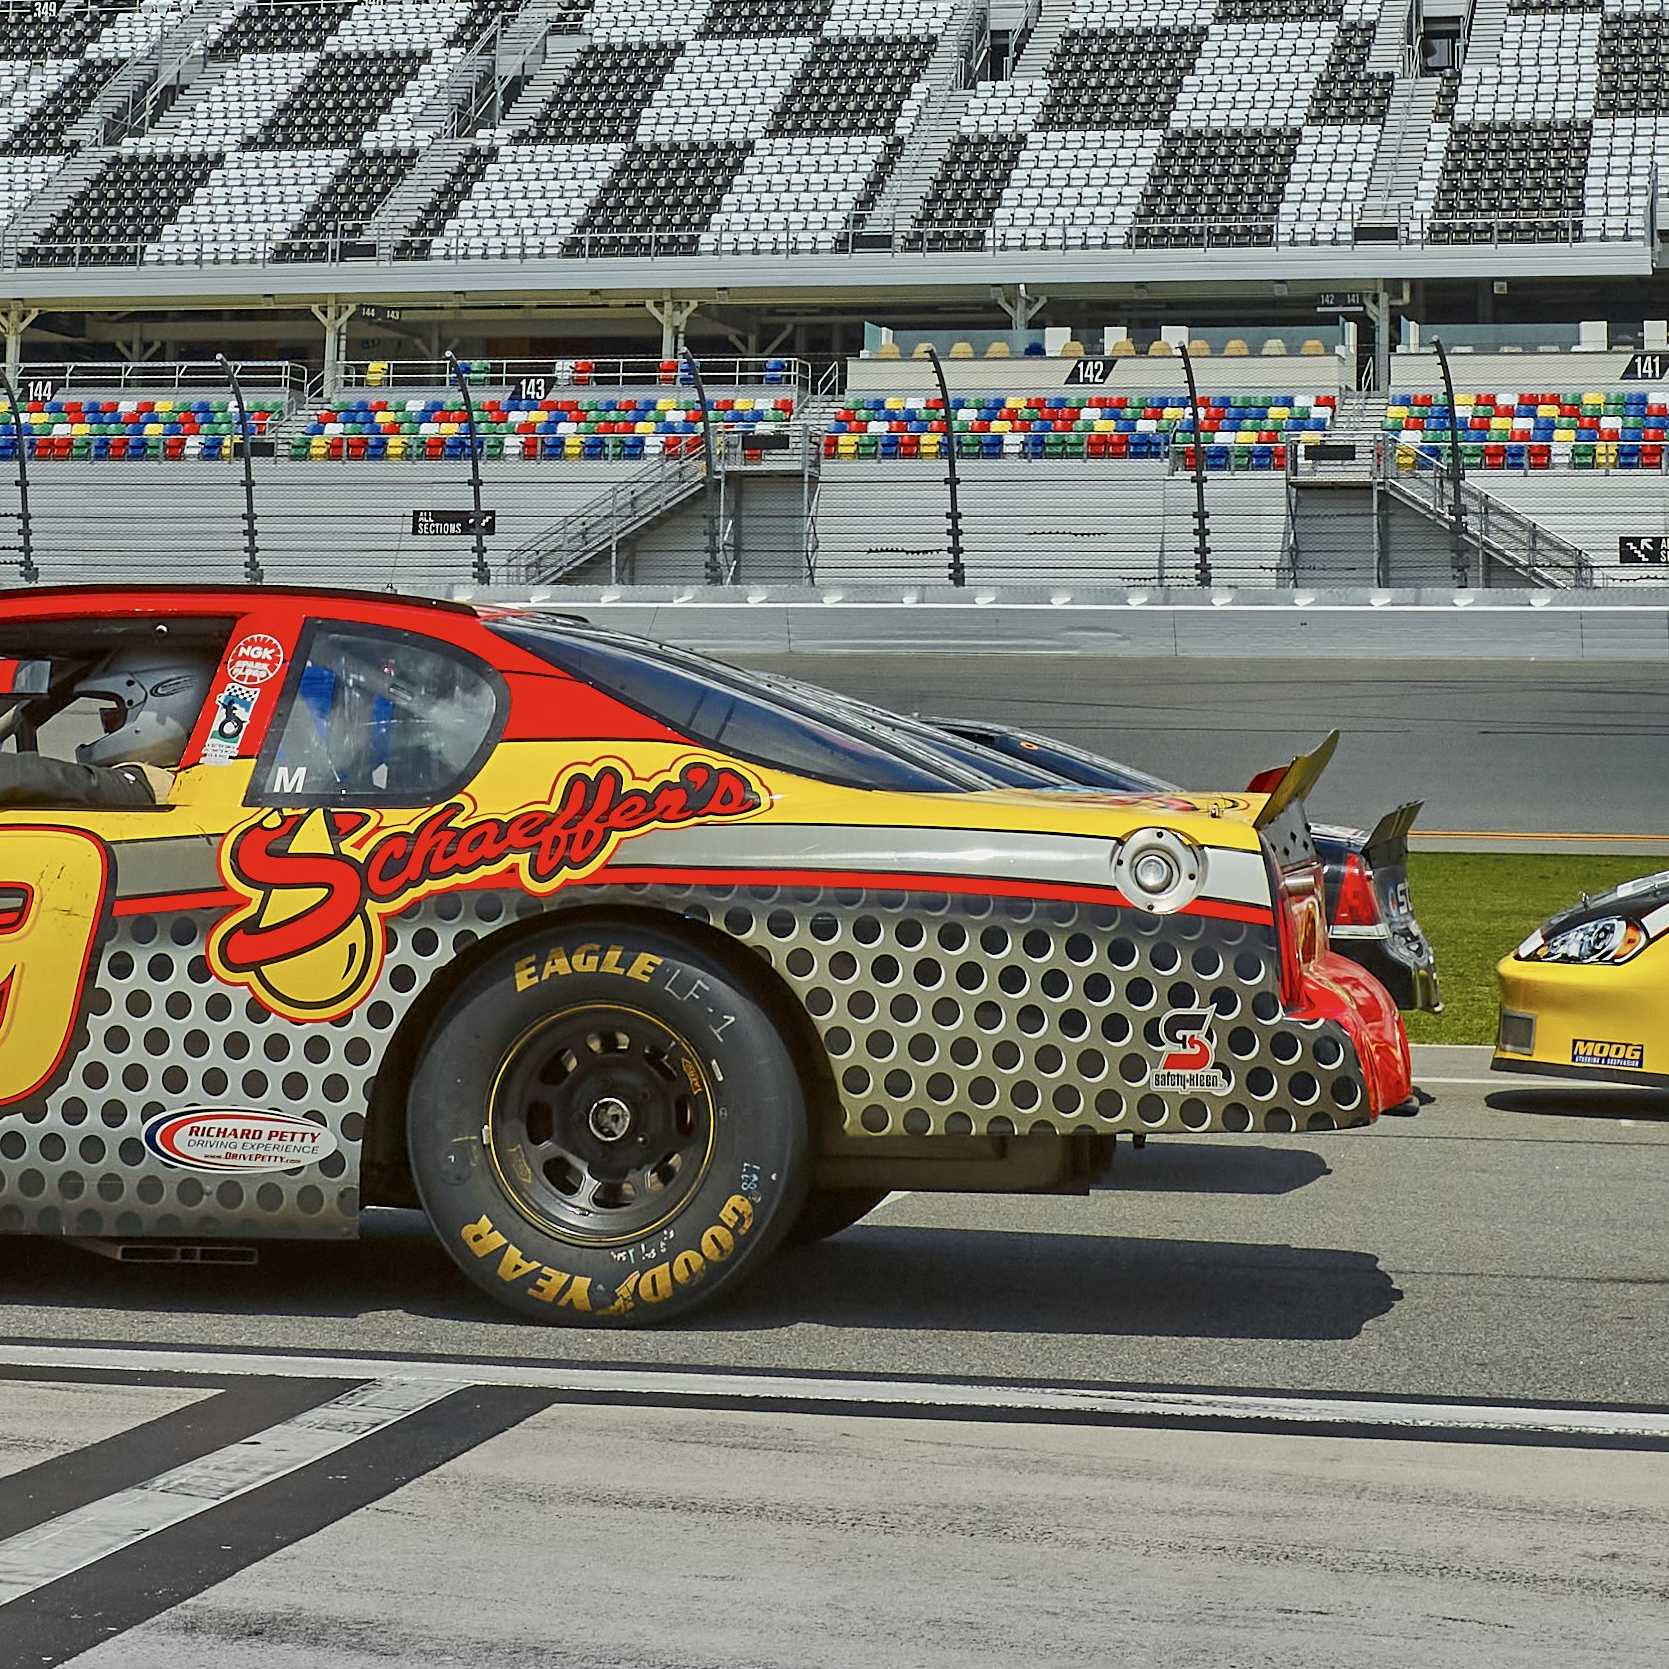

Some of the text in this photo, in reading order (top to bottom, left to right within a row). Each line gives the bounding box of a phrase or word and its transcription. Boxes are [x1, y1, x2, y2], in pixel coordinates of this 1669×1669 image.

[34, 1, 56, 17] 349
[1320, 294, 1360, 304] 142 141
[1077, 360, 1105, 383] 142
[1634, 355, 1661, 379] 141
[27, 381, 53, 401] 144
[519, 378, 546, 401] 143
[418, 512, 434, 522] ALL
[417, 522, 462, 534] SECTIONS
[238, 645, 276, 661] NGK
[273, 766, 307, 793] M
[218, 765, 758, 971] Schaeffer's
[514, 944, 664, 992] EAGLE
[1573, 1039, 1643, 1061] MOOG
[188, 1125, 322, 1143] RICHARD PETTY
[187, 1138, 320, 1154] DRIVING EXPERIENCE
[460, 1194, 755, 1318] GOODYEAR
